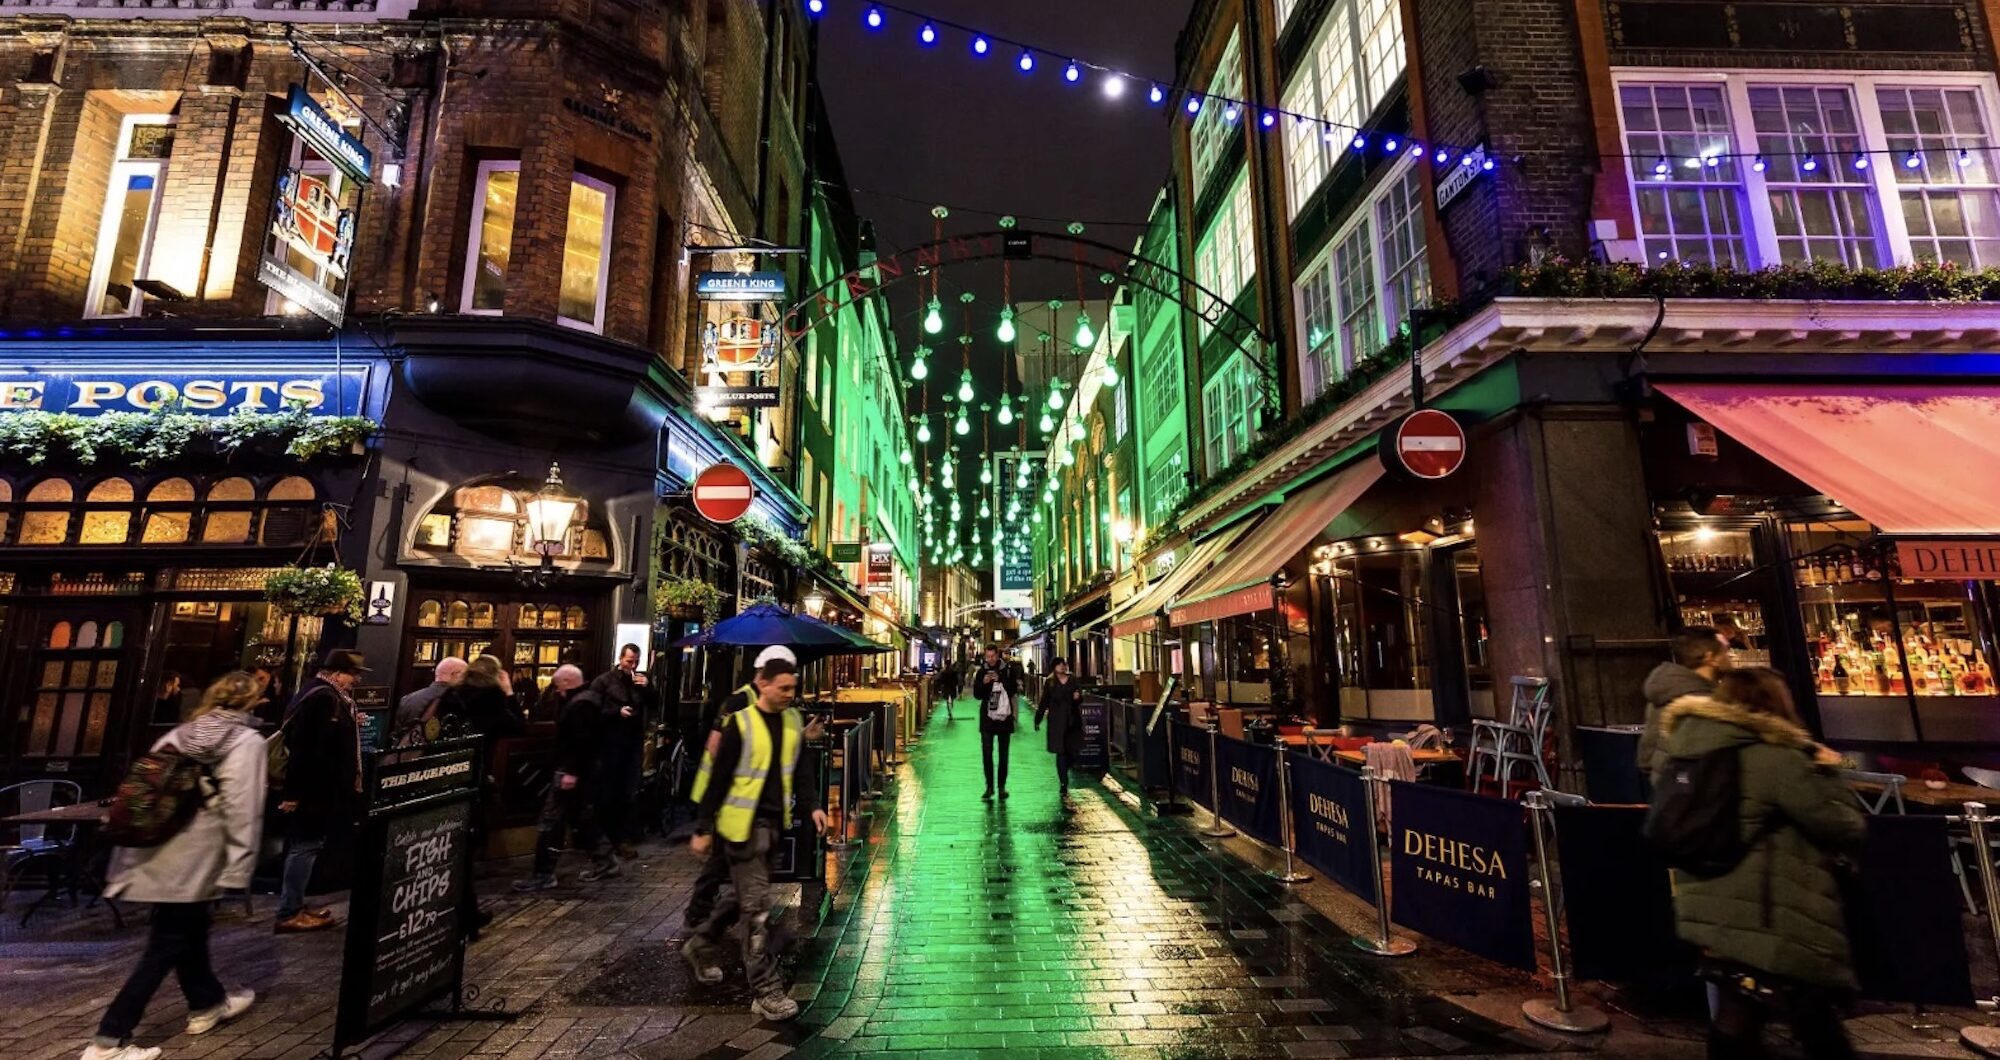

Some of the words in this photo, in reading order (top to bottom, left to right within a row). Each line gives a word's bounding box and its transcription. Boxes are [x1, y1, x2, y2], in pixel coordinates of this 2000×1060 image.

[301, 106, 341, 146] GREENE
[341, 139, 365, 167] KING
[265, 261, 288, 281] THE
[707, 278, 747, 289] GREENE
[749, 278, 776, 289] KING
[68, 379, 326, 411] POSTS
[746, 392, 776, 401] POSTS
[871, 553, 890, 564] PIX
[381, 774, 407, 789] THE
[407, 767, 438, 784] BLUE
[438, 761, 470, 778] POSTS
[1231, 766, 1260, 792] DEHESA
[1309, 793, 1350, 829] DEHESA
[1316, 821, 1334, 837] TAPAS
[1335, 831, 1348, 844] BAR
[405, 832, 453, 873] FISH
[1404, 829, 1507, 880] DEHESA
[416, 865, 434, 880] AND
[1416, 866, 1460, 889] TAPAS
[1467, 881, 1495, 900] BAR
[392, 869, 452, 914] CHIPS
